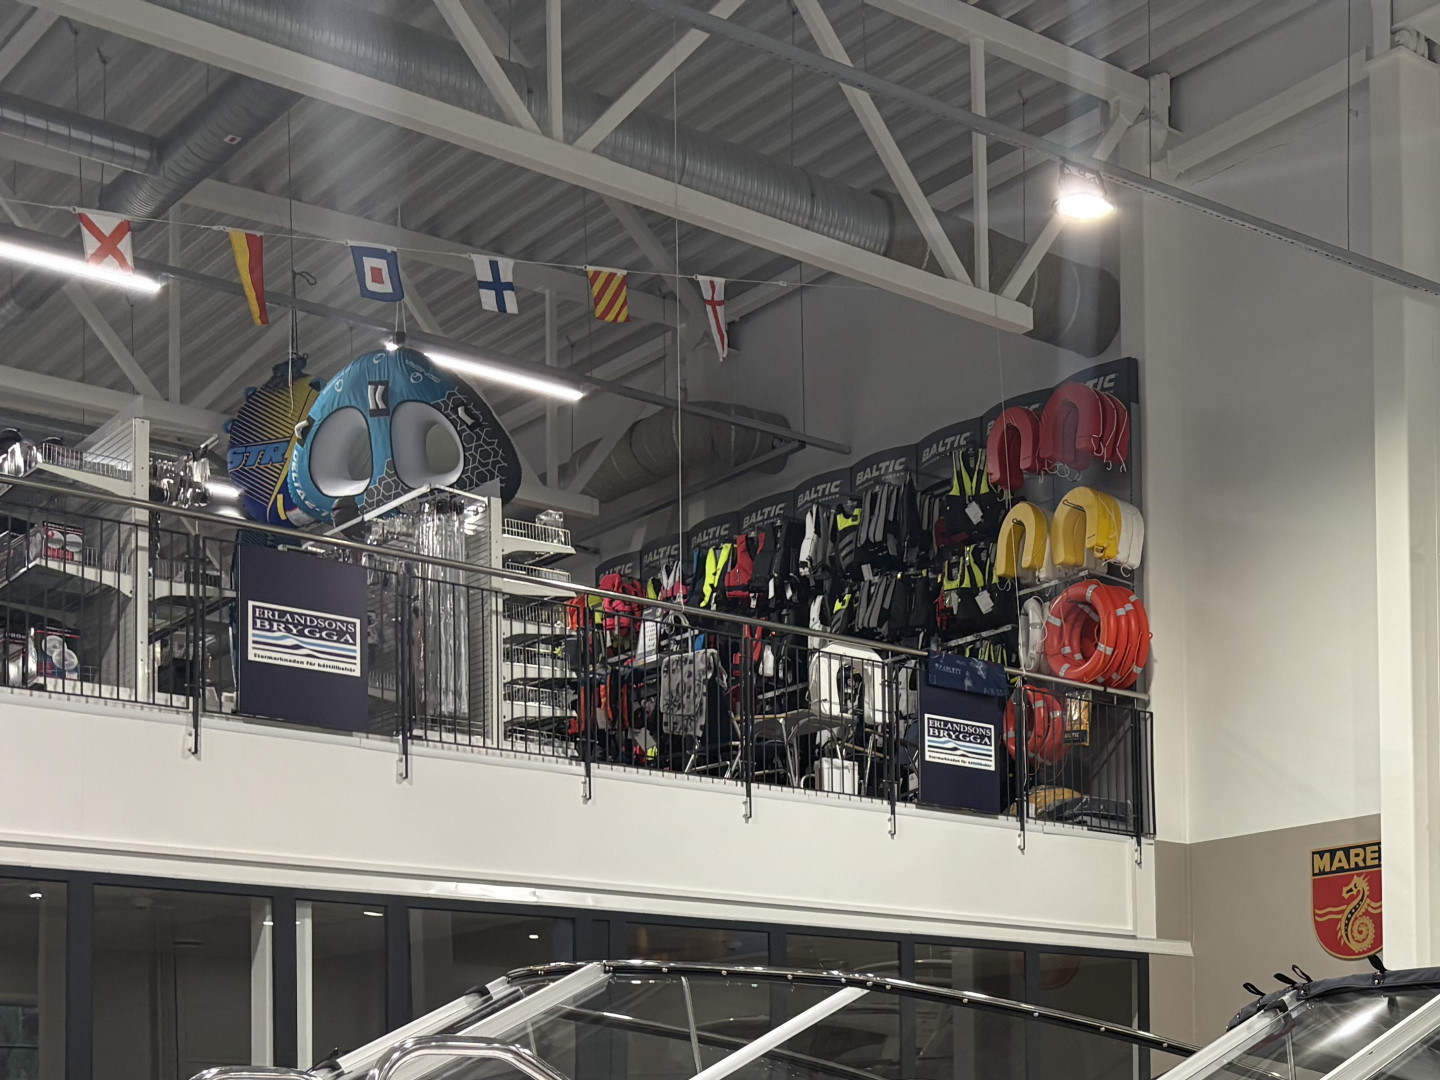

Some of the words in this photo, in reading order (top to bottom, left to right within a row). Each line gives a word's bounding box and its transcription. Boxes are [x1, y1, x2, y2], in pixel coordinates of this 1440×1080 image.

[922, 432, 971, 462] BALTIC
[855, 458, 905, 486] BALTIC
[797, 480, 842, 507] BALTIC
[743, 503, 786, 529] BALTIC
[691, 523, 730, 549] BALTIC
[643, 543, 680, 565] BALTIC
[254, 608, 355, 633] ERLANDSONS
[254, 619, 355, 644] BRYGGA
[929, 719, 991, 737] ERLANDSONS
[929, 728, 991, 745] BRYGGA
[1313, 845, 1381, 874] MARE
